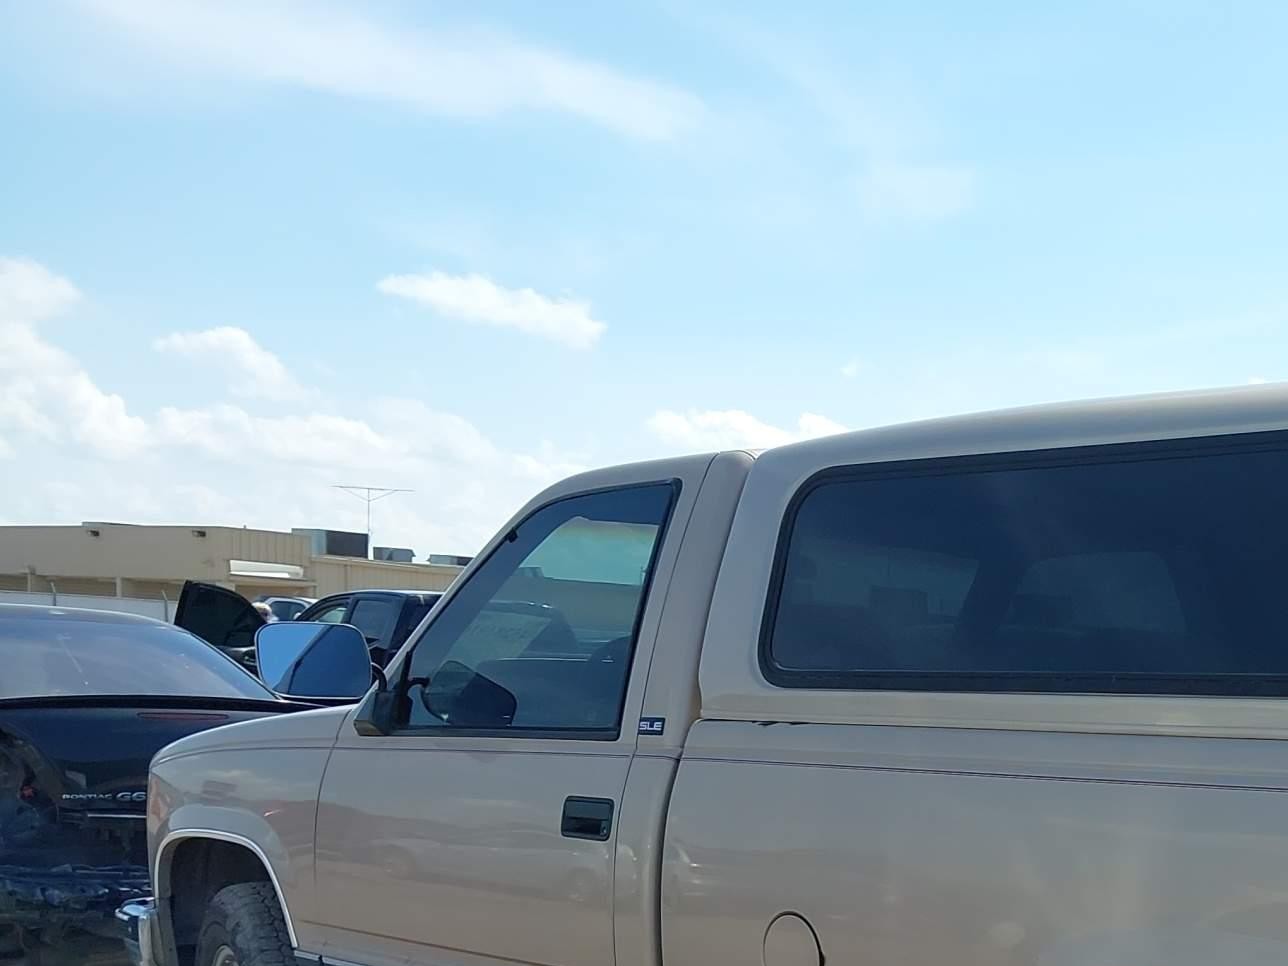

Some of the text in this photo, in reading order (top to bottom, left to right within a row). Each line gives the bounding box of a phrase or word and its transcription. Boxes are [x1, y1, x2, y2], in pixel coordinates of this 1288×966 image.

[639, 721, 662, 731] SLE
[62, 791, 147, 802] PONTIAC G6
